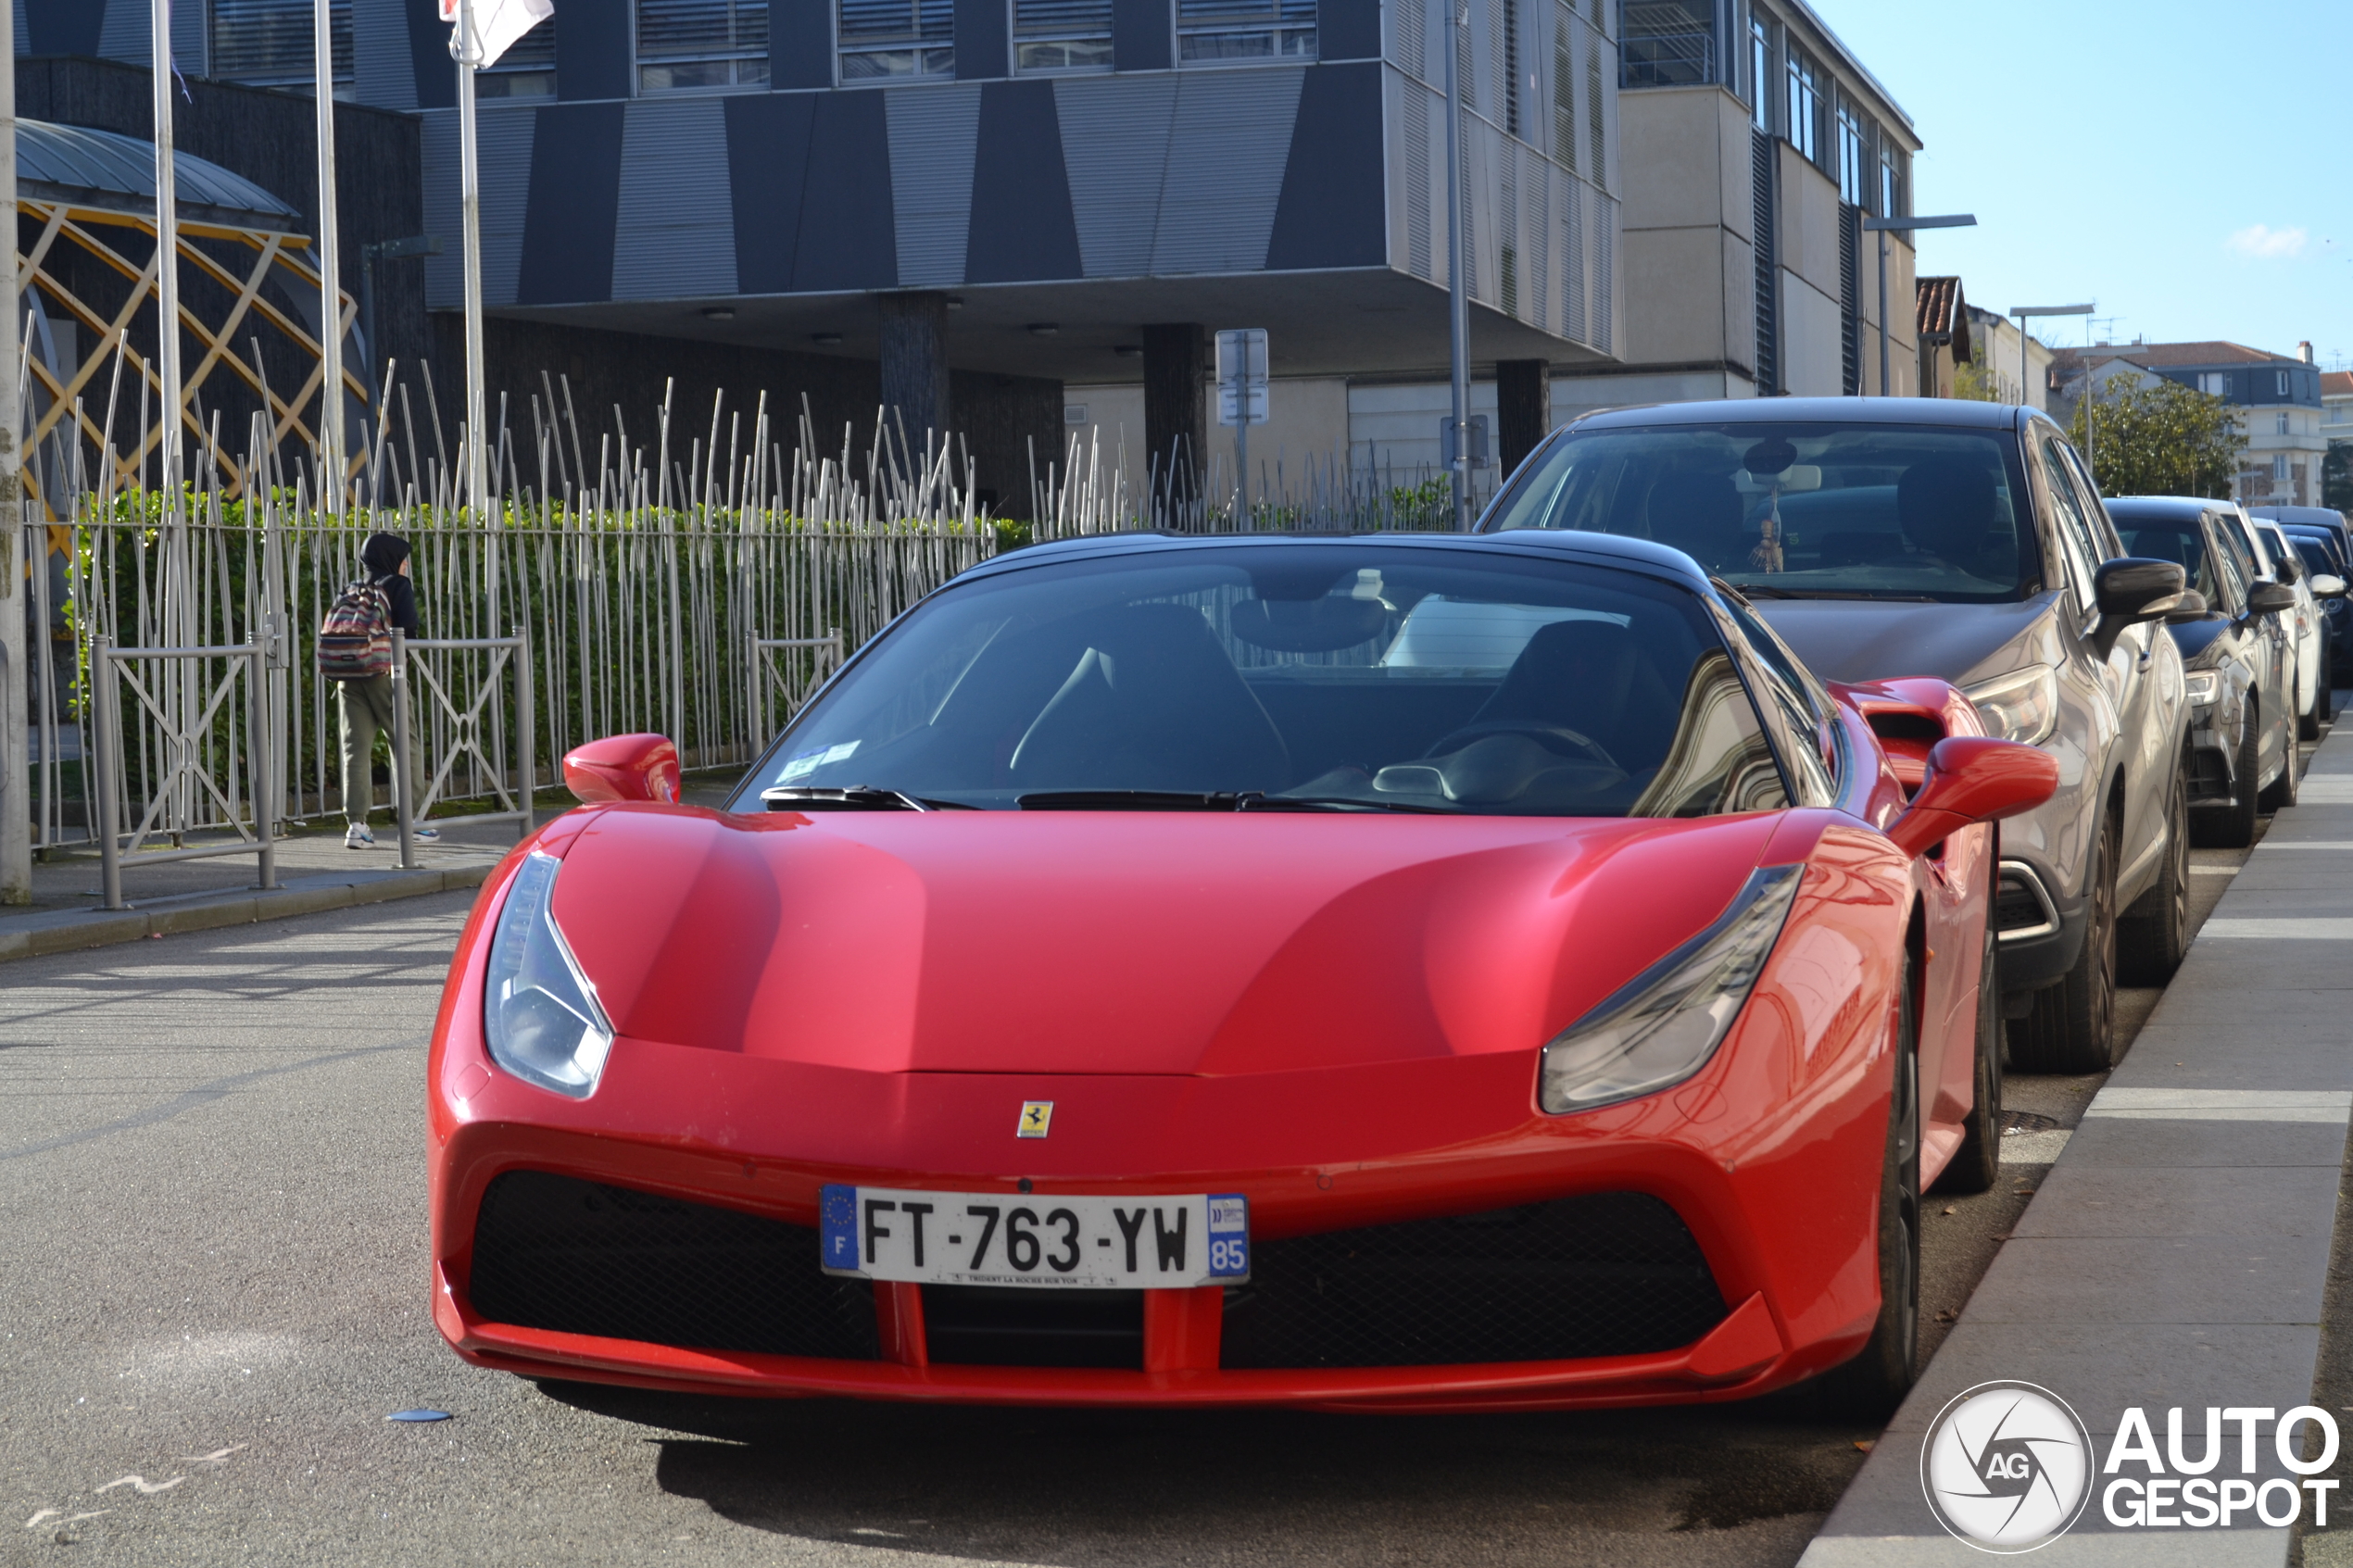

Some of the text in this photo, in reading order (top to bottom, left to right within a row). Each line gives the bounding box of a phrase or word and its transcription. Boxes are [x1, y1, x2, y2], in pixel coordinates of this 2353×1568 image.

[835, 1236, 847, 1255] F
[863, 1198, 1188, 1273] FT-763-YW
[1211, 1239, 1246, 1271] 85
[1003, 1275, 1013, 1284] LA
[1044, 1276, 1060, 1285] SUR
